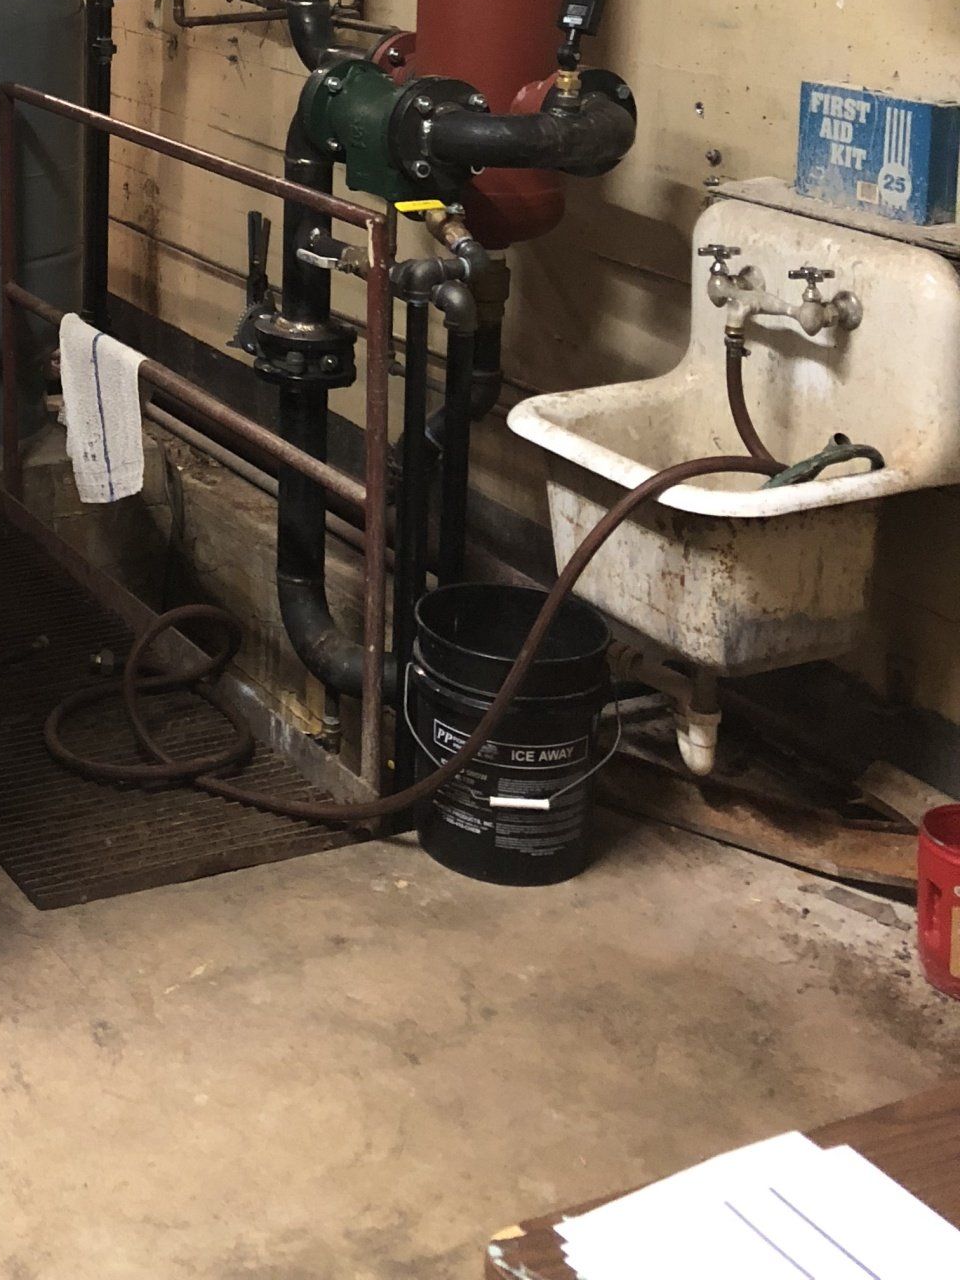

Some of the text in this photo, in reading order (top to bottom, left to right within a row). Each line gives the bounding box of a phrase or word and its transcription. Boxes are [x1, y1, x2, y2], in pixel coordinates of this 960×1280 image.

[809, 91, 871, 124] FIRST
[819, 117, 854, 144] AID
[830, 142, 867, 170] KIT
[883, 174, 906, 193] 25
[511, 746, 575, 762] ICE AWAY
